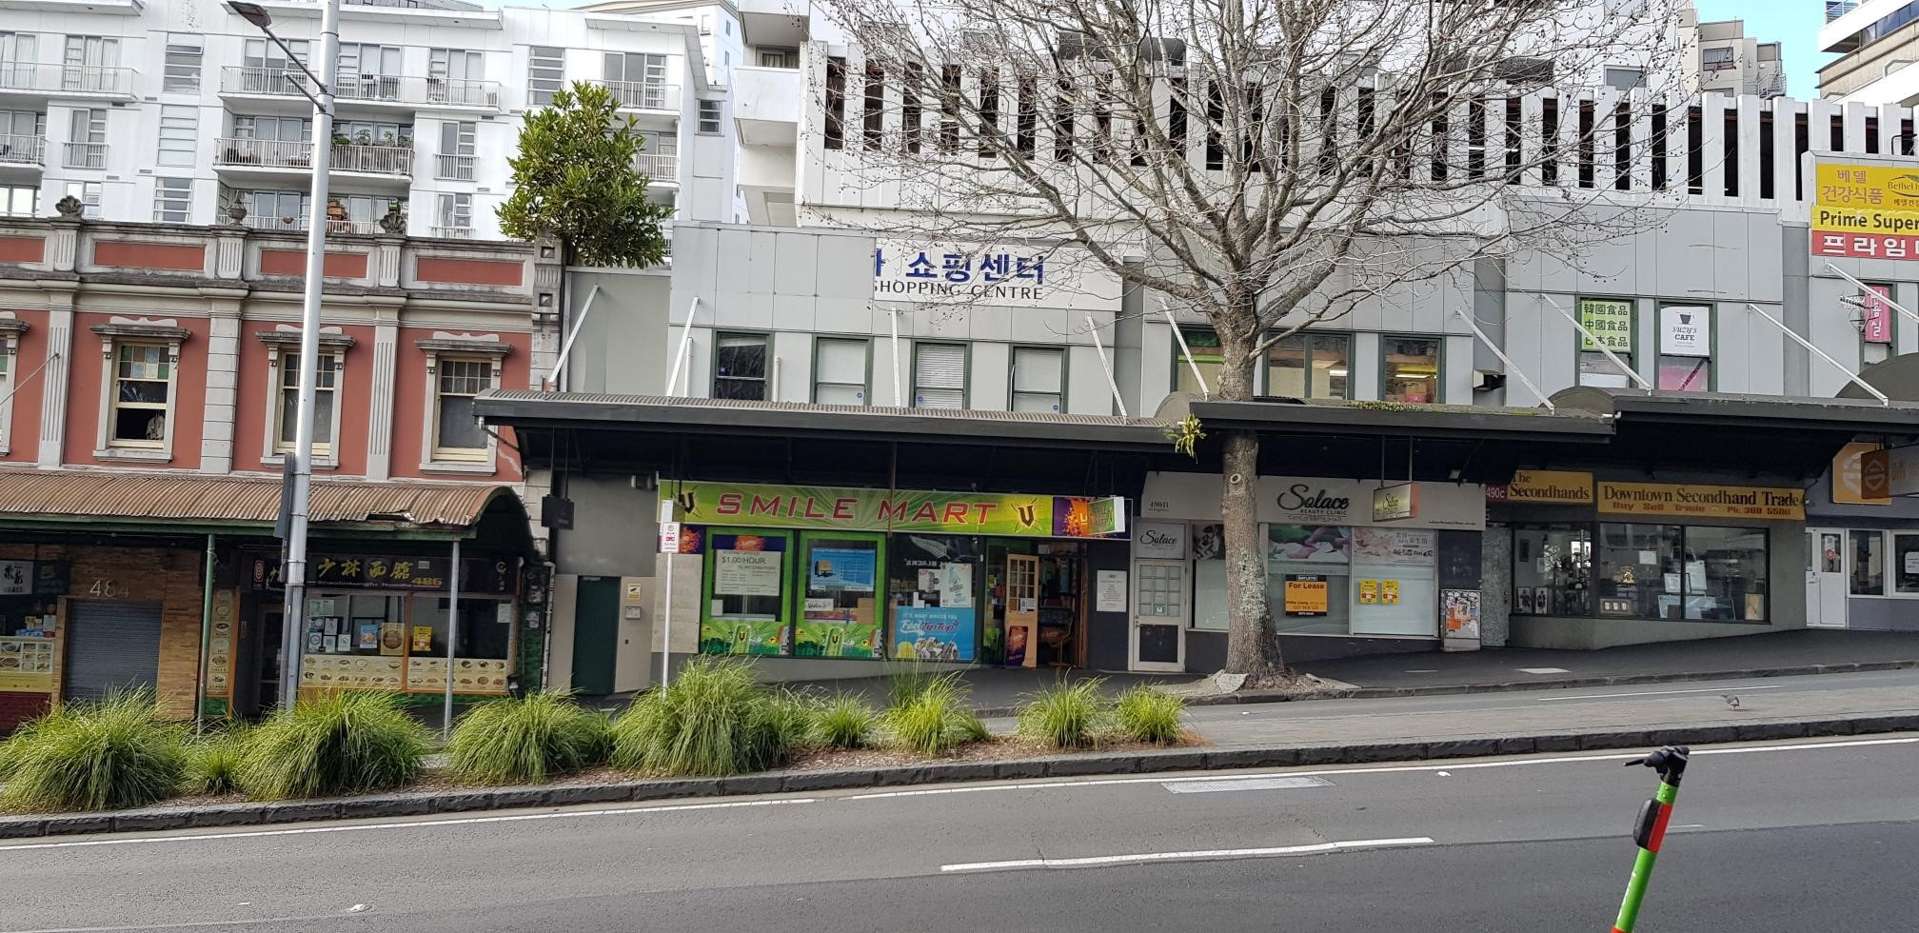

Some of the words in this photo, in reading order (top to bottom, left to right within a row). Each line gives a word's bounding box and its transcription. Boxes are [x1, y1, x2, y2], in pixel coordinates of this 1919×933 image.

[1822, 185, 1884, 205] 건강식품
[1819, 210, 1868, 228] Prime
[1822, 235, 1919, 257] 프라임
[905, 251, 1045, 285] 쇼핑센터
[970, 284, 1044, 300] CENTRE
[1583, 303, 1628, 316] 韓國食品
[1584, 319, 1628, 332] 中國食品
[1276, 483, 1351, 511] Solace
[1509, 483, 1591, 500] Secondhands
[1603, 485, 1673, 501] Downtown
[1676, 488, 1757, 506] Secondhand
[1761, 491, 1800, 507] Trade
[716, 493, 858, 520] SMILE
[877, 500, 998, 525] MART
[1612, 502, 1635, 512] Buy
[1140, 529, 1177, 545] Solace
